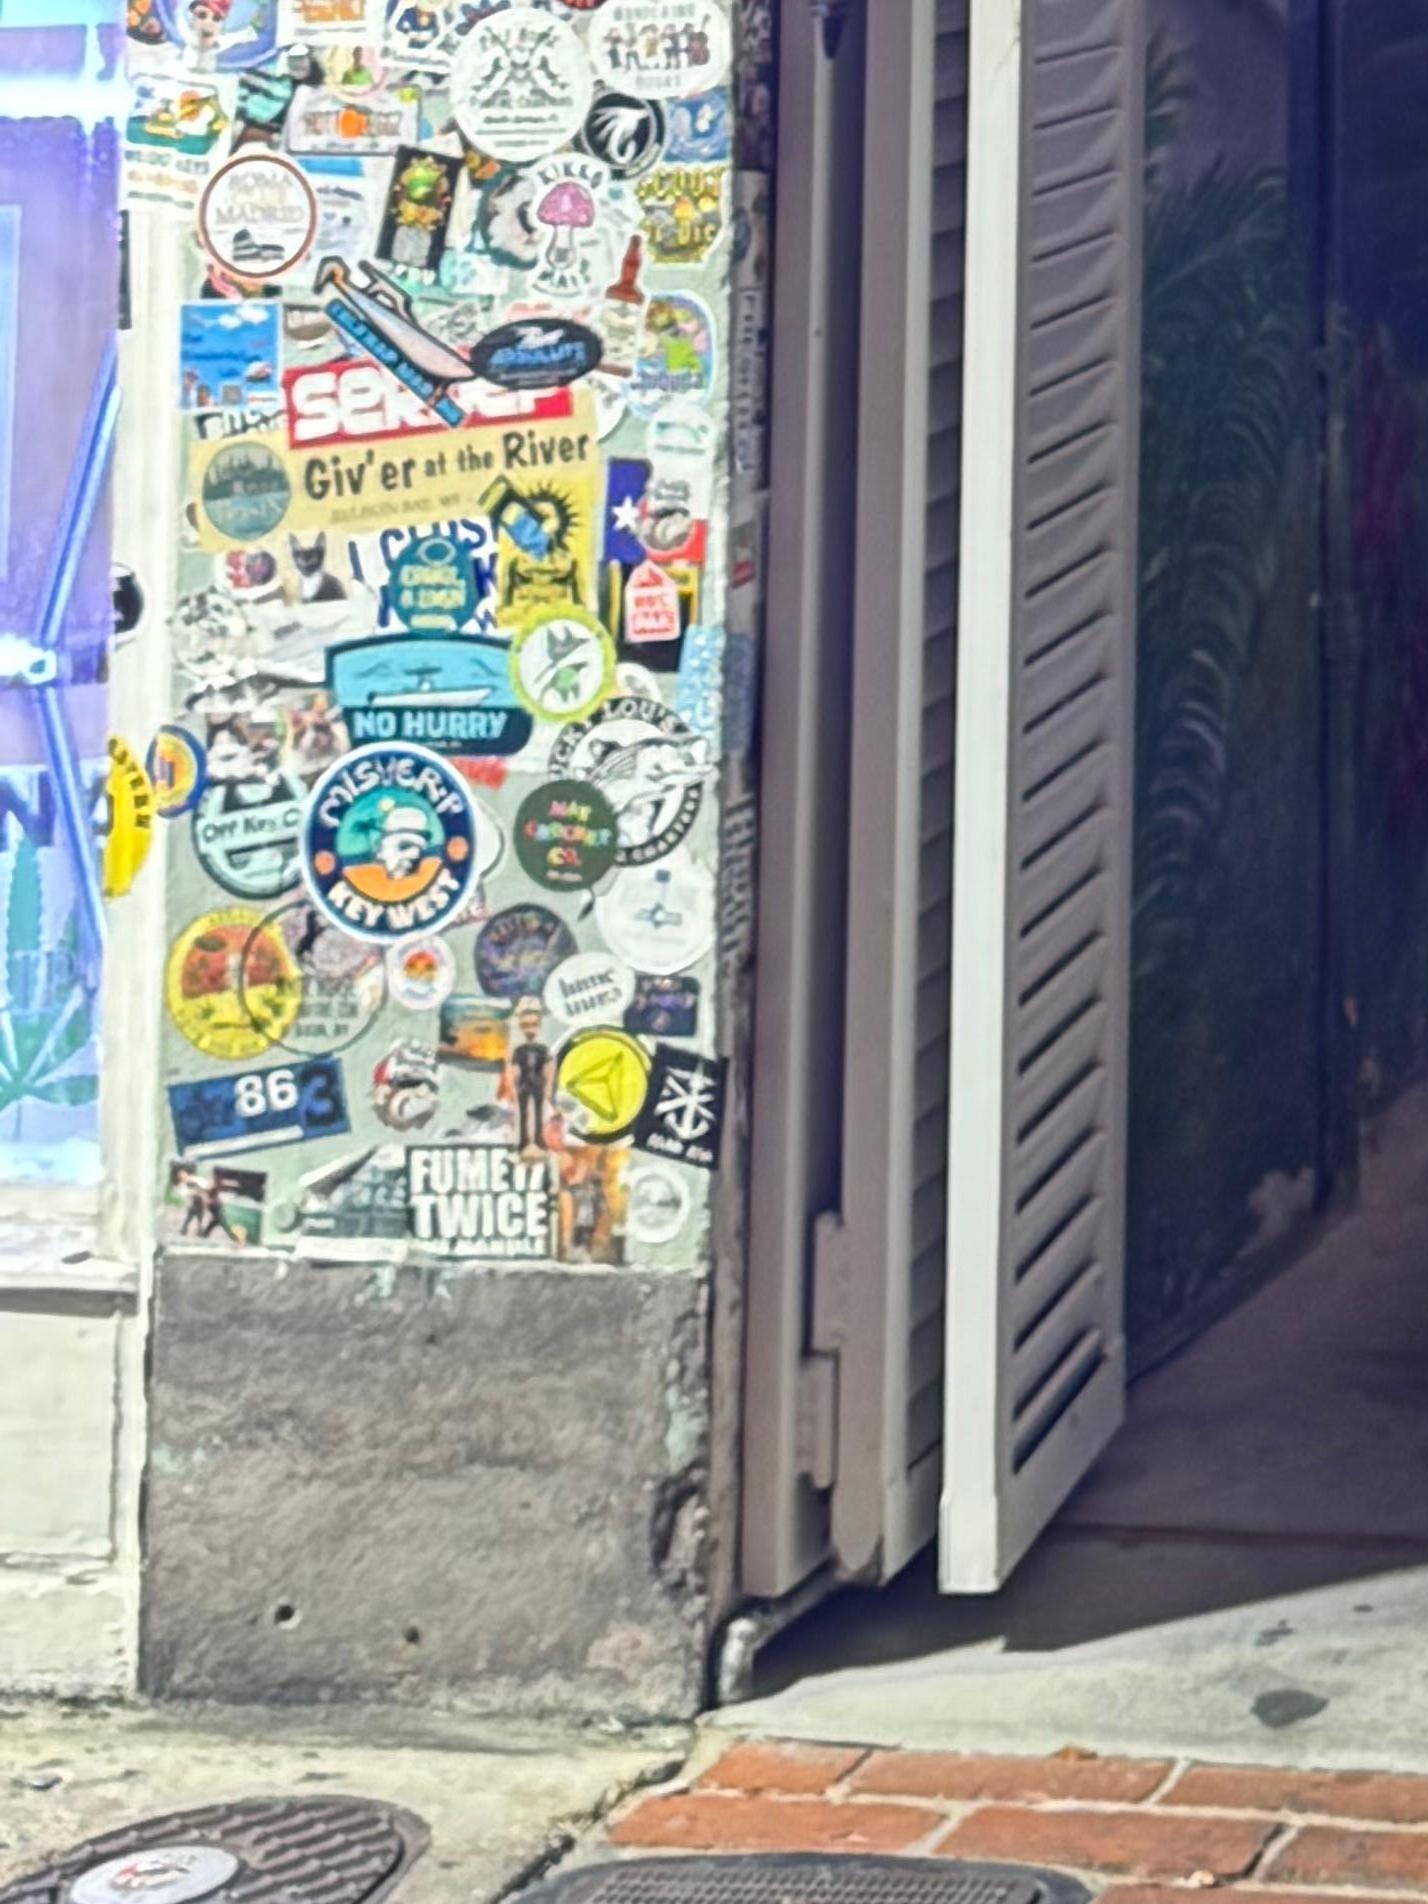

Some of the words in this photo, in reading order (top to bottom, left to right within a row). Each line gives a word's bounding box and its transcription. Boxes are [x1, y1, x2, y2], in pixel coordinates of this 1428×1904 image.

[304, 449, 419, 502] Giv'er
[424, 457, 448, 477] at
[458, 442, 494, 473] the
[501, 430, 590, 472] River
[353, 713, 396, 739] NO
[404, 711, 510, 739] HURRY
[325, 881, 384, 926] KEY
[385, 869, 461, 930] WEST
[233, 1069, 299, 1120] 86
[411, 1149, 512, 1192] FUME
[411, 1191, 550, 1238] TWICE
